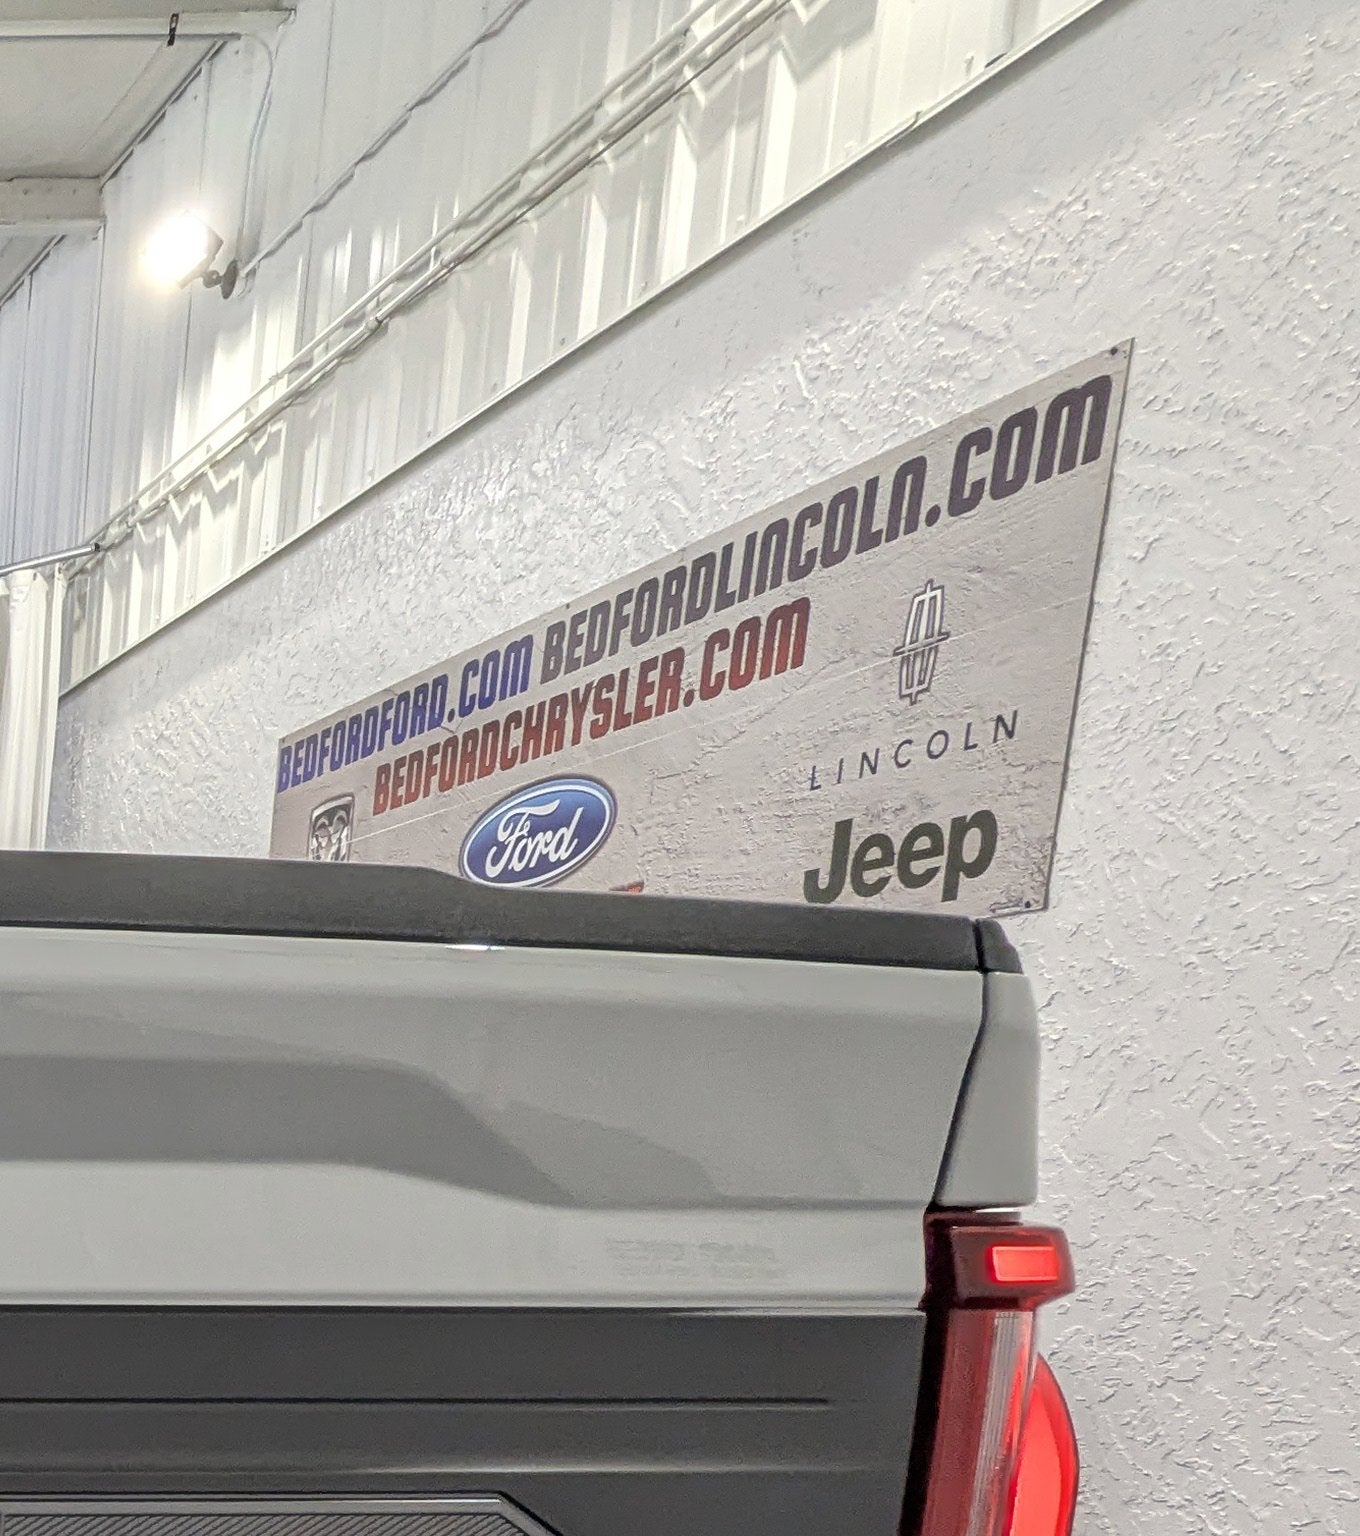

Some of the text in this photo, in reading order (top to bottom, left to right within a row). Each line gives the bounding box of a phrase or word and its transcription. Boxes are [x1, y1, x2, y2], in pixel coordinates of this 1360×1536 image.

[276, 373, 1113, 795] BEDFORDFORD.COM BEDFORDLINCOLN.COM
[372, 596, 811, 817] BEDFORDCHRYSLER.COM
[809, 709, 1019, 791] LINCOLN
[484, 799, 584, 878] Ford
[803, 809, 999, 904] Jeep
